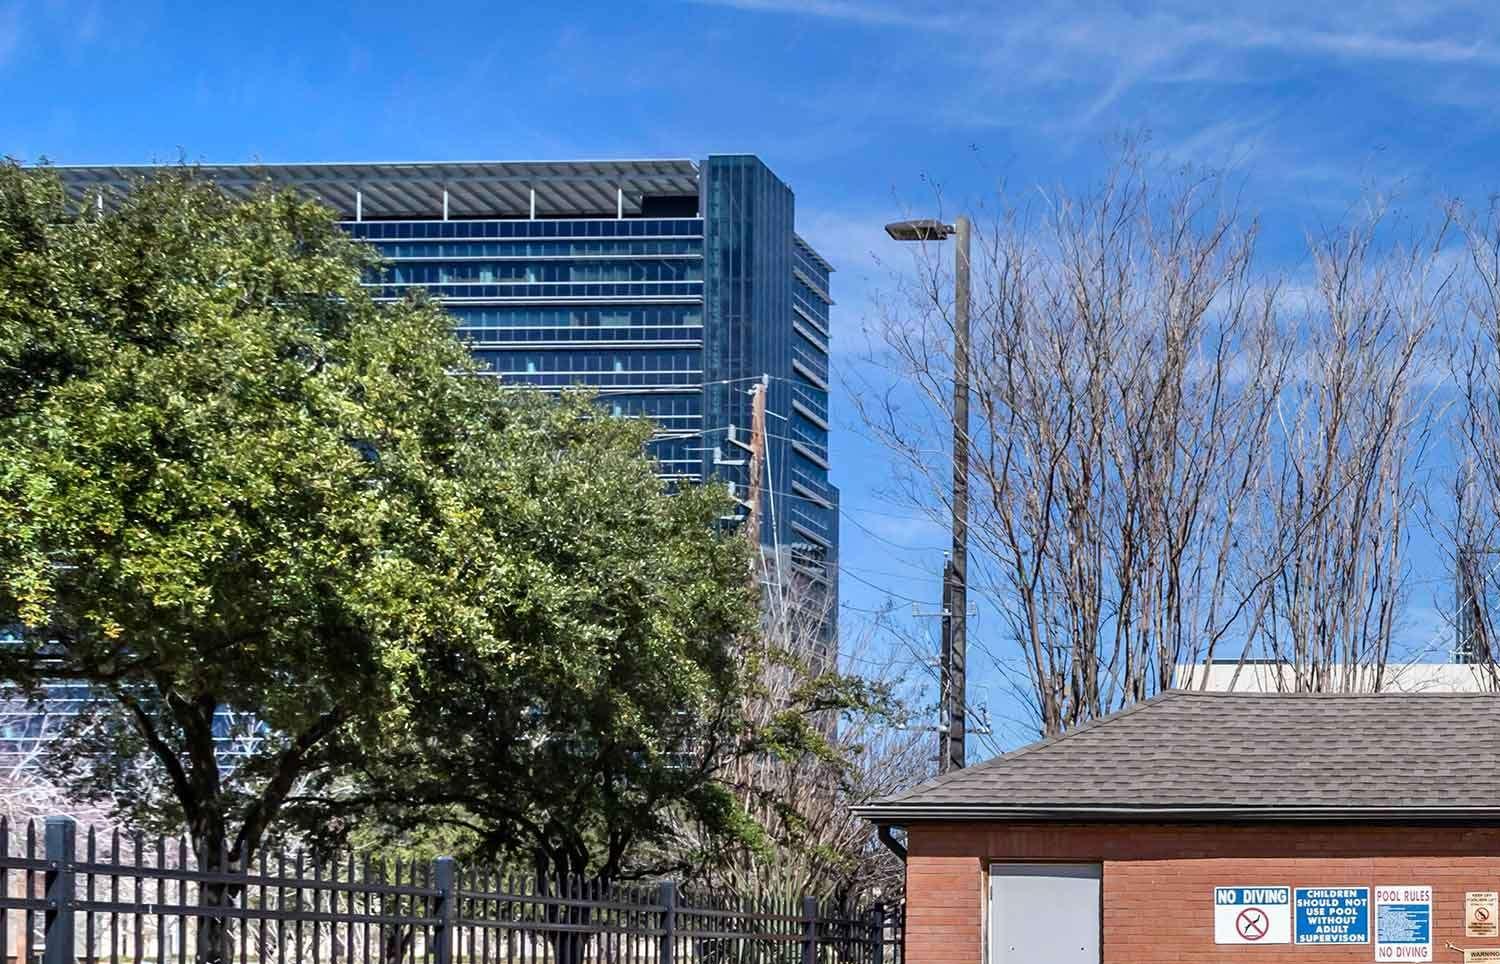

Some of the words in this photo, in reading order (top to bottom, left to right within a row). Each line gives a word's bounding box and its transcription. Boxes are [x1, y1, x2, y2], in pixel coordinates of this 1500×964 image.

[1218, 889, 1236, 904] NO
[1243, 889, 1287, 904] DIVING
[1377, 891, 1400, 902] POOL
[1404, 891, 1430, 902] RULES
[1297, 899, 1339, 907] SHOULD
[1379, 946, 1392, 957] NO
[1396, 946, 1428, 958] DIVING
